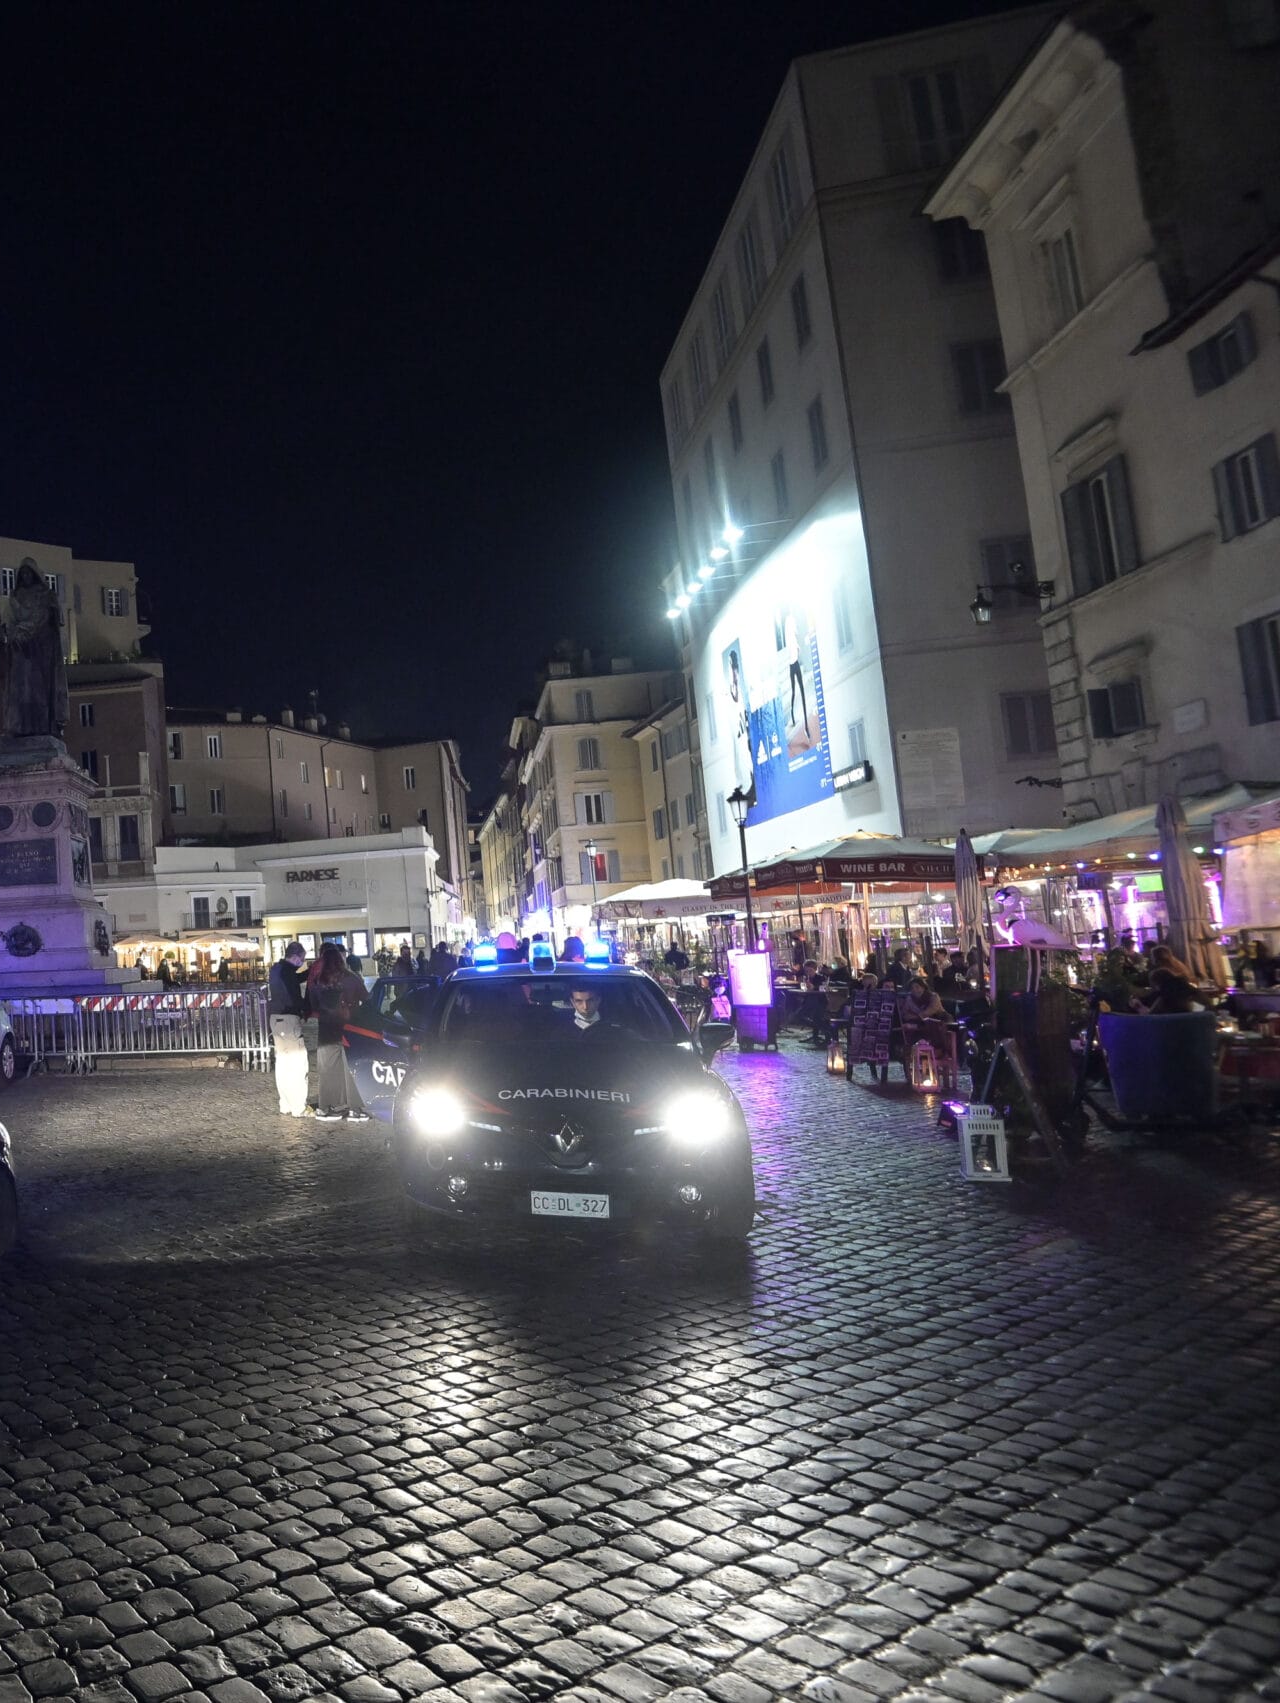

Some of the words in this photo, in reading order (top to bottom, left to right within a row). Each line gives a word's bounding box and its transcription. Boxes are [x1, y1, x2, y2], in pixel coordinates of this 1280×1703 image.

[840, 863, 875, 873] WINE
[879, 862, 906, 872] BAR
[286, 868, 340, 883] FARNESE
[498, 1088, 630, 1103] CARABINIERI
[533, 1196, 549, 1210] CC
[558, 1197, 574, 1212] DL
[582, 1198, 607, 1213] 327
